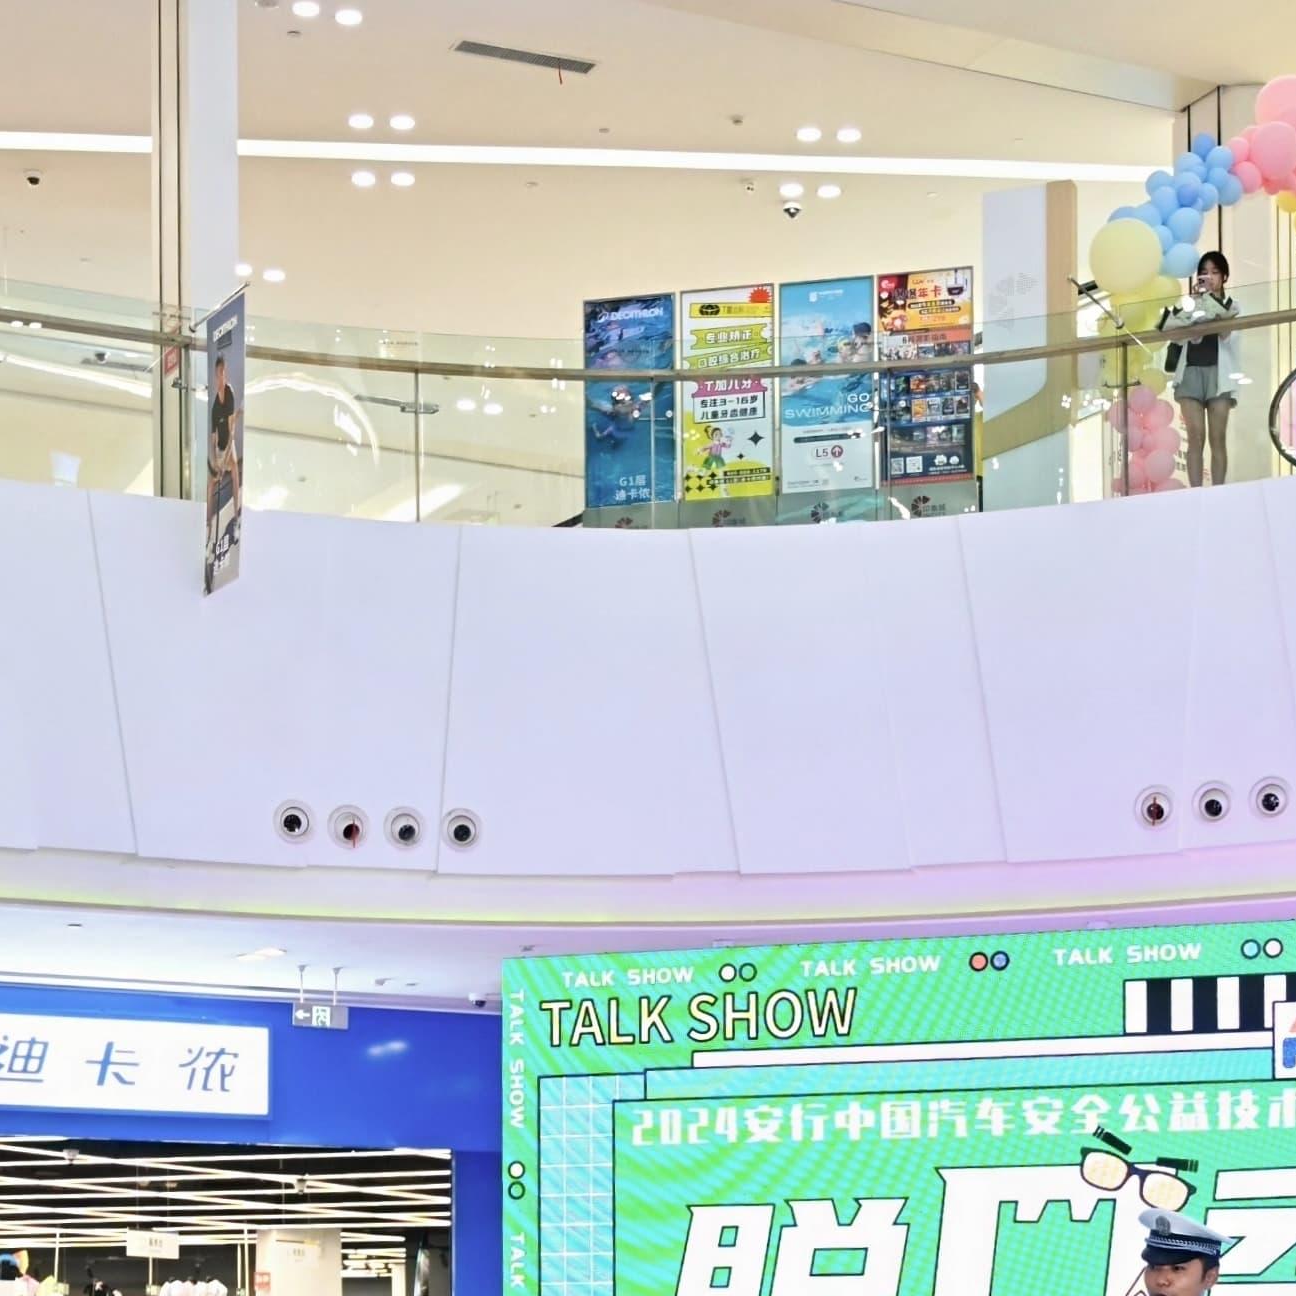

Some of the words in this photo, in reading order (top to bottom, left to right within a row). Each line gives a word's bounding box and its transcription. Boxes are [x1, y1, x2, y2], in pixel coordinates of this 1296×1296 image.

[847, 393, 870, 403] GO
[784, 404, 871, 419] SWIMMING
[815, 448, 829, 458] L5
[618, 475, 647, 487] G1层
[1054, 946, 1113, 965] TALK
[1127, 942, 1203, 963] SHOW
[561, 970, 615, 988] TALK
[628, 966, 696, 985] SHOW
[801, 958, 857, 977] TALK
[870, 955, 941, 975] SHOW
[508, 990, 525, 1046] TALK
[539, 994, 675, 1048] TALK
[687, 986, 858, 1042] SHOW
[508, 1059, 525, 1129] SHOW
[510, 1233, 525, 1289] TALK
